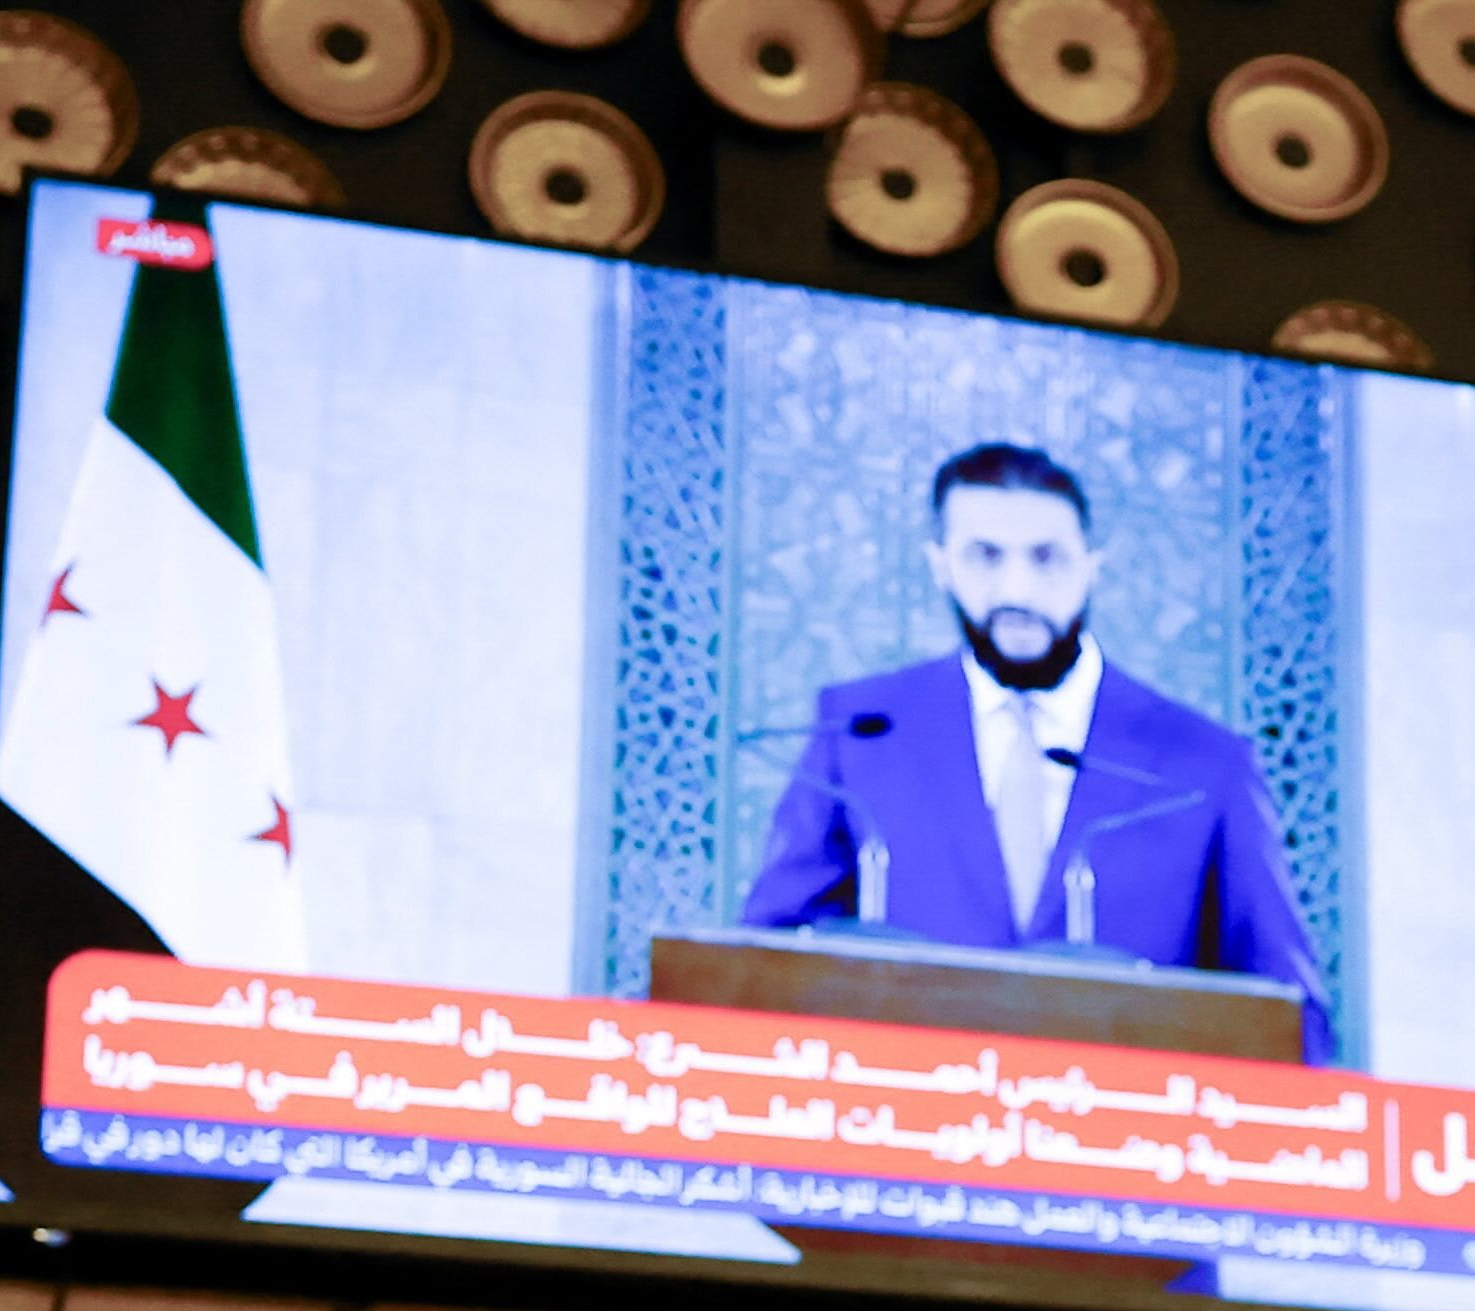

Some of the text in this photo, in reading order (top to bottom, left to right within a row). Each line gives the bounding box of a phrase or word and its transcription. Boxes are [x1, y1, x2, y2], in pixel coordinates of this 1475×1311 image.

[461, 1007, 634, 1061] خلال
[82, 1034, 244, 1091] سوريا
[246, 1050, 356, 1113] في
[830, 1047, 998, 1096] أحمد
[998, 1064, 1196, 1116] الرئيس
[1196, 1085, 1369, 1133] السيد
[1185, 1133, 1369, 1190] الماضية
